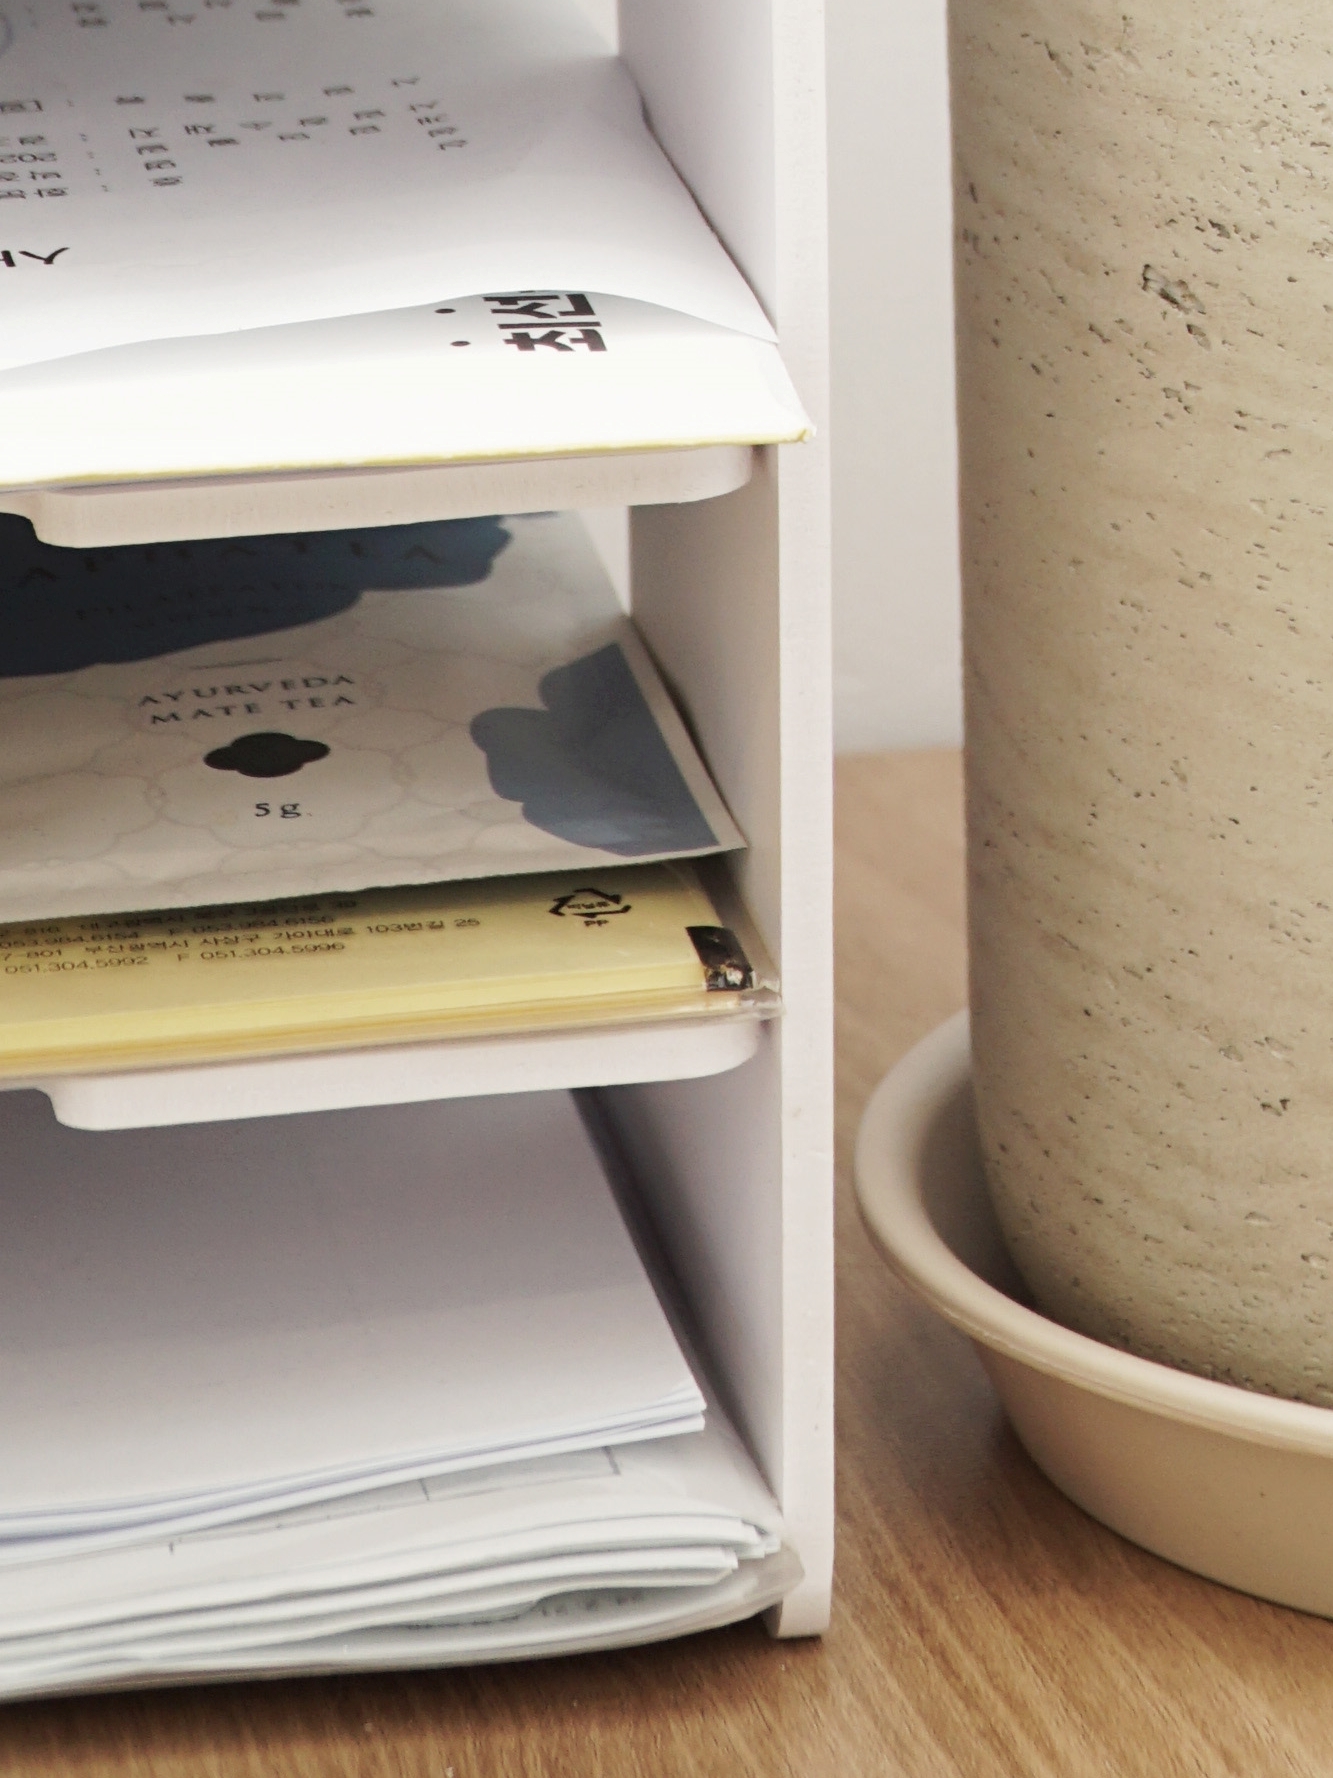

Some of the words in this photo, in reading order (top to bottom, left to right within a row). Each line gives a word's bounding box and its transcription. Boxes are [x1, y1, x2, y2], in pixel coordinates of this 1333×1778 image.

[483, 290, 608, 352] 최선
[139, 675, 355, 707] AYURVEDA
[152, 703, 262, 725] MATE
[279, 695, 355, 711] TEA
